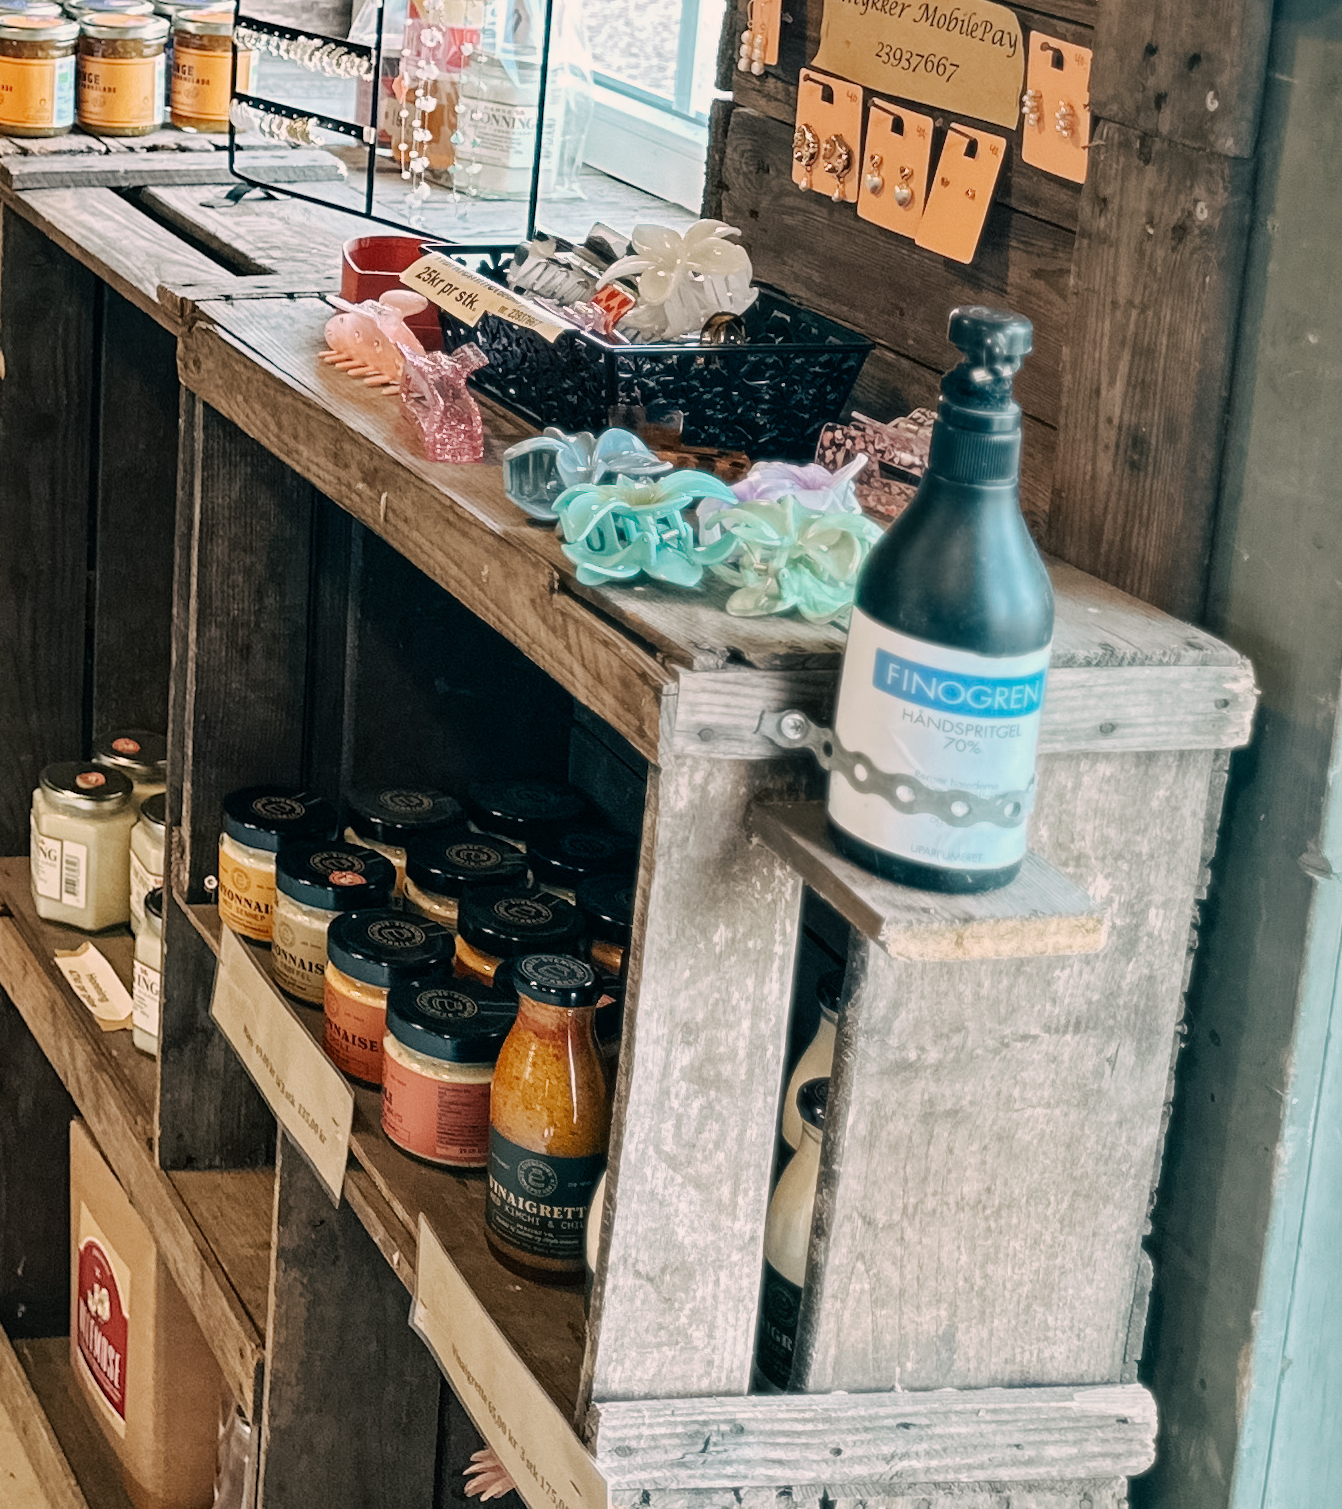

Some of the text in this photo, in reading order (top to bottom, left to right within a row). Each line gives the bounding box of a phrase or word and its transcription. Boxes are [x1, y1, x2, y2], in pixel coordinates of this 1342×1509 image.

[913, 2, 1019, 59] MobilePay
[874, 41, 961, 84] 23937667
[414, 266, 444, 289] 25kr
[439, 282, 457, 298] pr
[454, 290, 481, 313] stk.
[886, 661, 1041, 711] FINOGREN
[901, 707, 1022, 739] HÅNDSPRITGEL
[943, 736, 982, 756] 70%
[489, 1174, 589, 1220] VINAIGRETT
